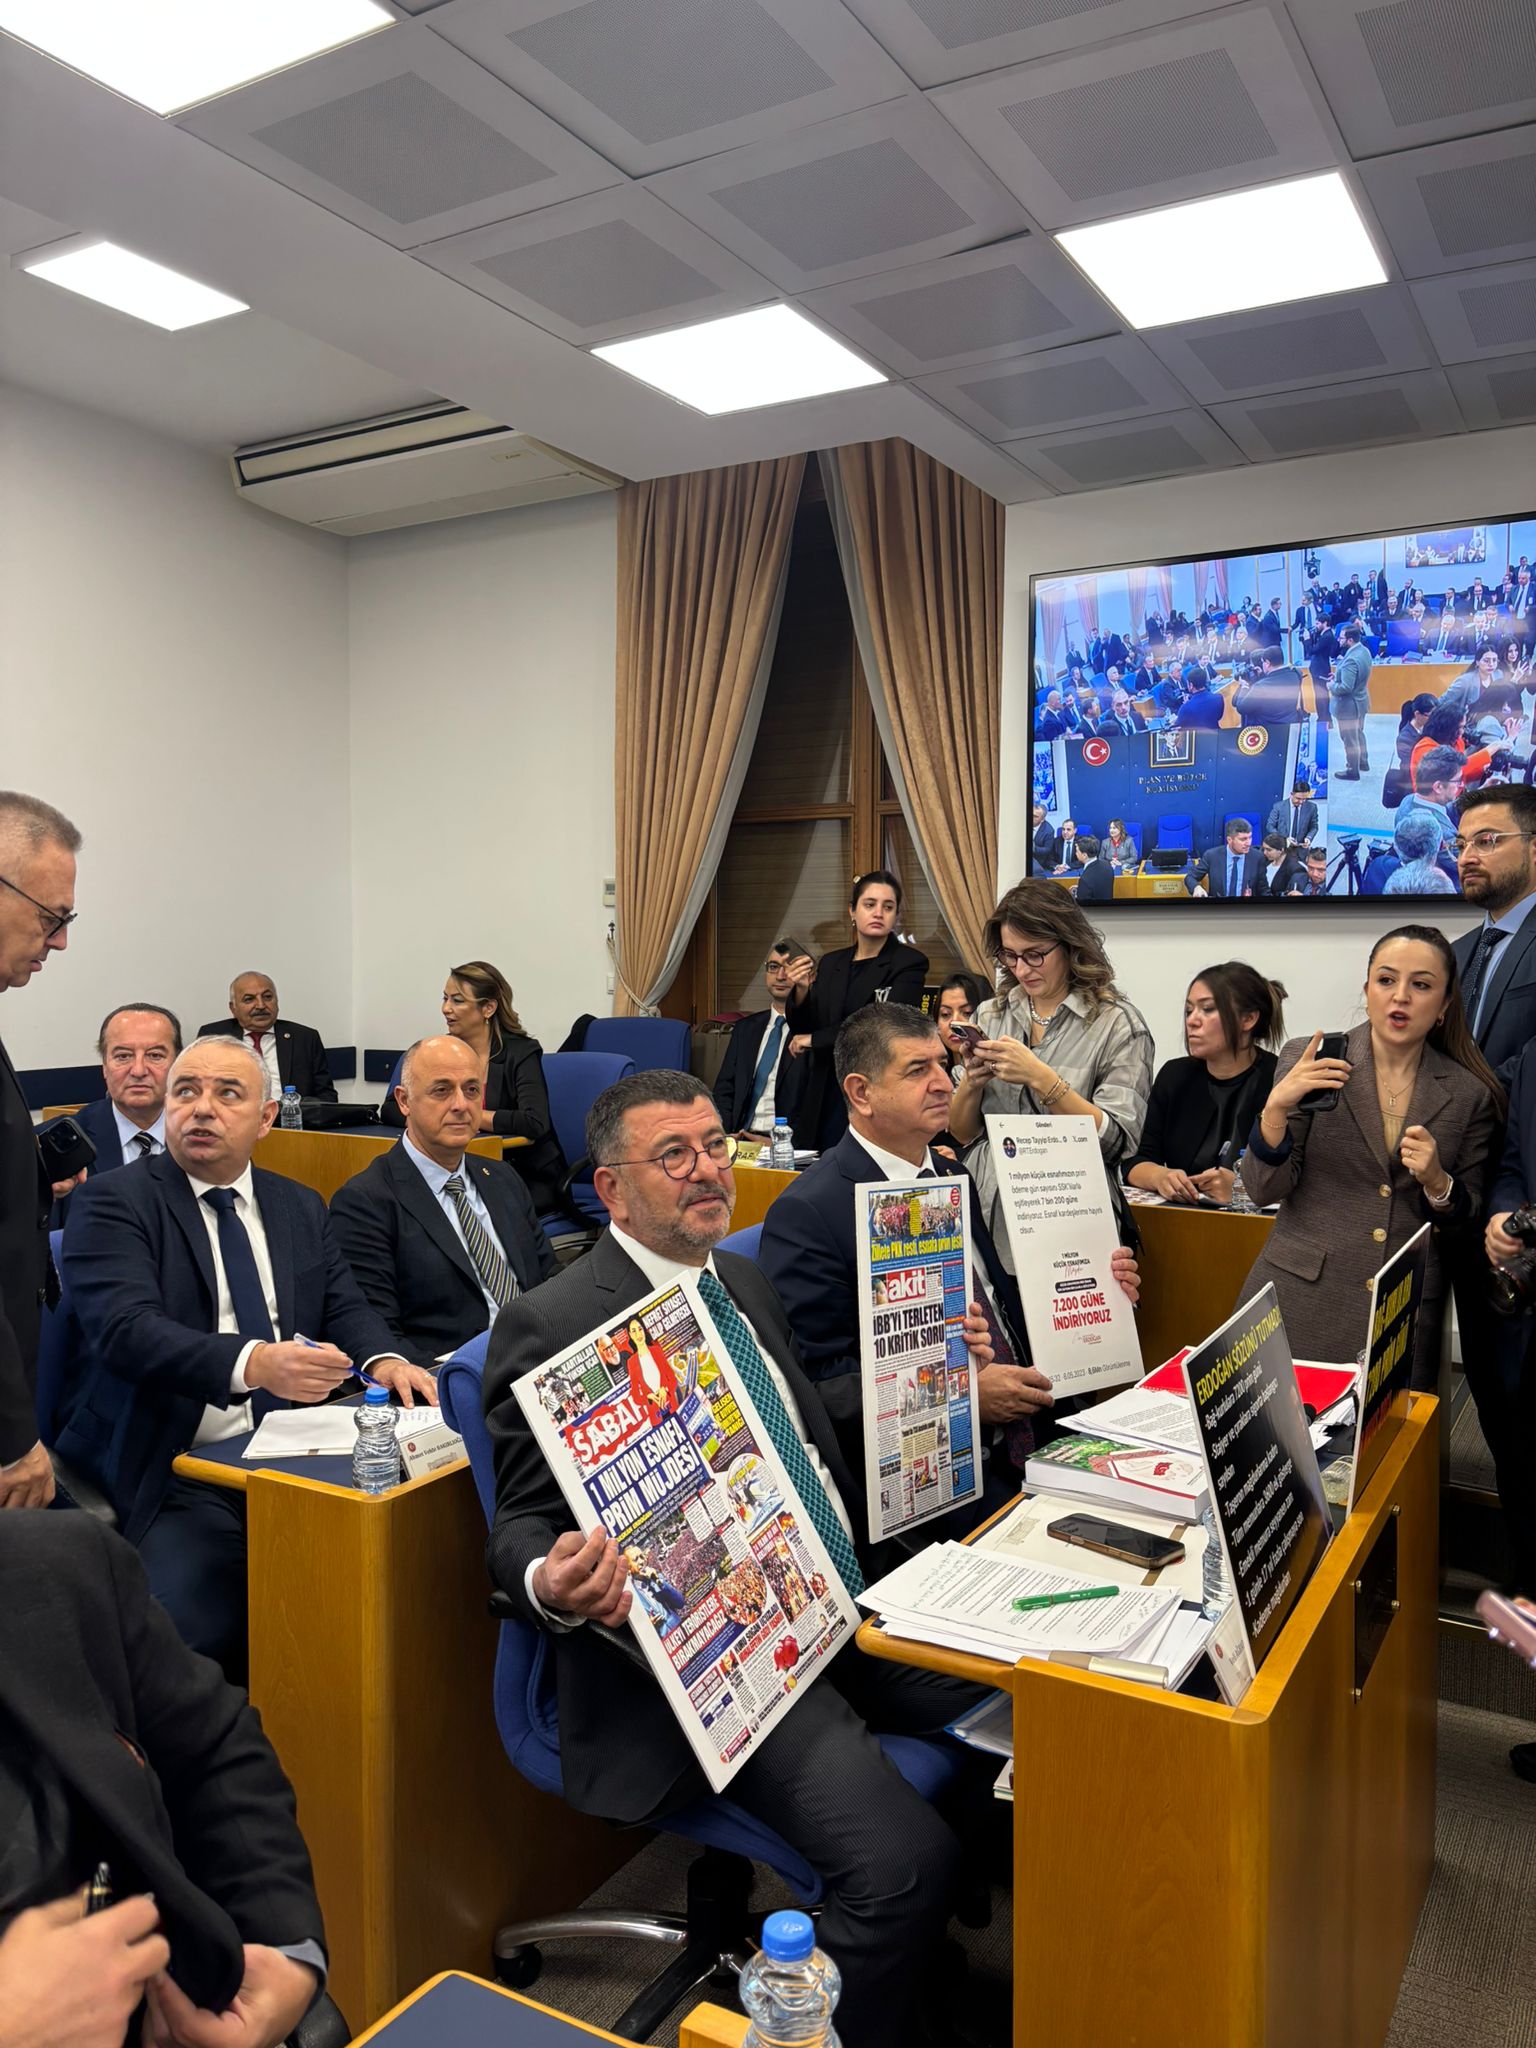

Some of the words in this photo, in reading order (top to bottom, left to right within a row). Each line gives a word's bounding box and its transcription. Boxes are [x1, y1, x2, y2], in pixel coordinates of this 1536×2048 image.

[1014, 1136, 1032, 1144] Recep
[1031, 1136, 1048, 1144] Tayyip
[1011, 1171, 1031, 1181] milyon
[1029, 1170, 1046, 1181] küçük
[1010, 1184, 1029, 1194] ödeme
[1028, 1184, 1040, 1194] gün
[1040, 1197, 1045, 1205] 7
[1044, 1196, 1054, 1205] bin
[1053, 1196, 1066, 1204] 200
[1064, 1195, 1079, 1205] güne
[1043, 1209, 1058, 1218] Esnaf
[887, 1268, 925, 1301] akit
[1051, 1295, 1079, 1313] 7.200
[1077, 1289, 1106, 1308] GÜNE
[872, 1309, 901, 1336] İBB'Yİ
[902, 1301, 944, 1330] TERLETEN
[1051, 1305, 1112, 1331] İNDİRİYORUZ
[873, 1336, 886, 1359] 10
[887, 1327, 920, 1356] KRİTİK
[919, 1322, 945, 1348] SORU
[1196, 1356, 1234, 1405] ERDOĞAN
[1231, 1335, 1257, 1370] SÖZÜNÜ
[587, 1480, 605, 1509] 1
[596, 1445, 649, 1502] MİLYON
[637, 1414, 687, 1469] ESNAFA
[599, 1485, 646, 1539] PRİM
[636, 1439, 702, 1508] MÜJDESİ
